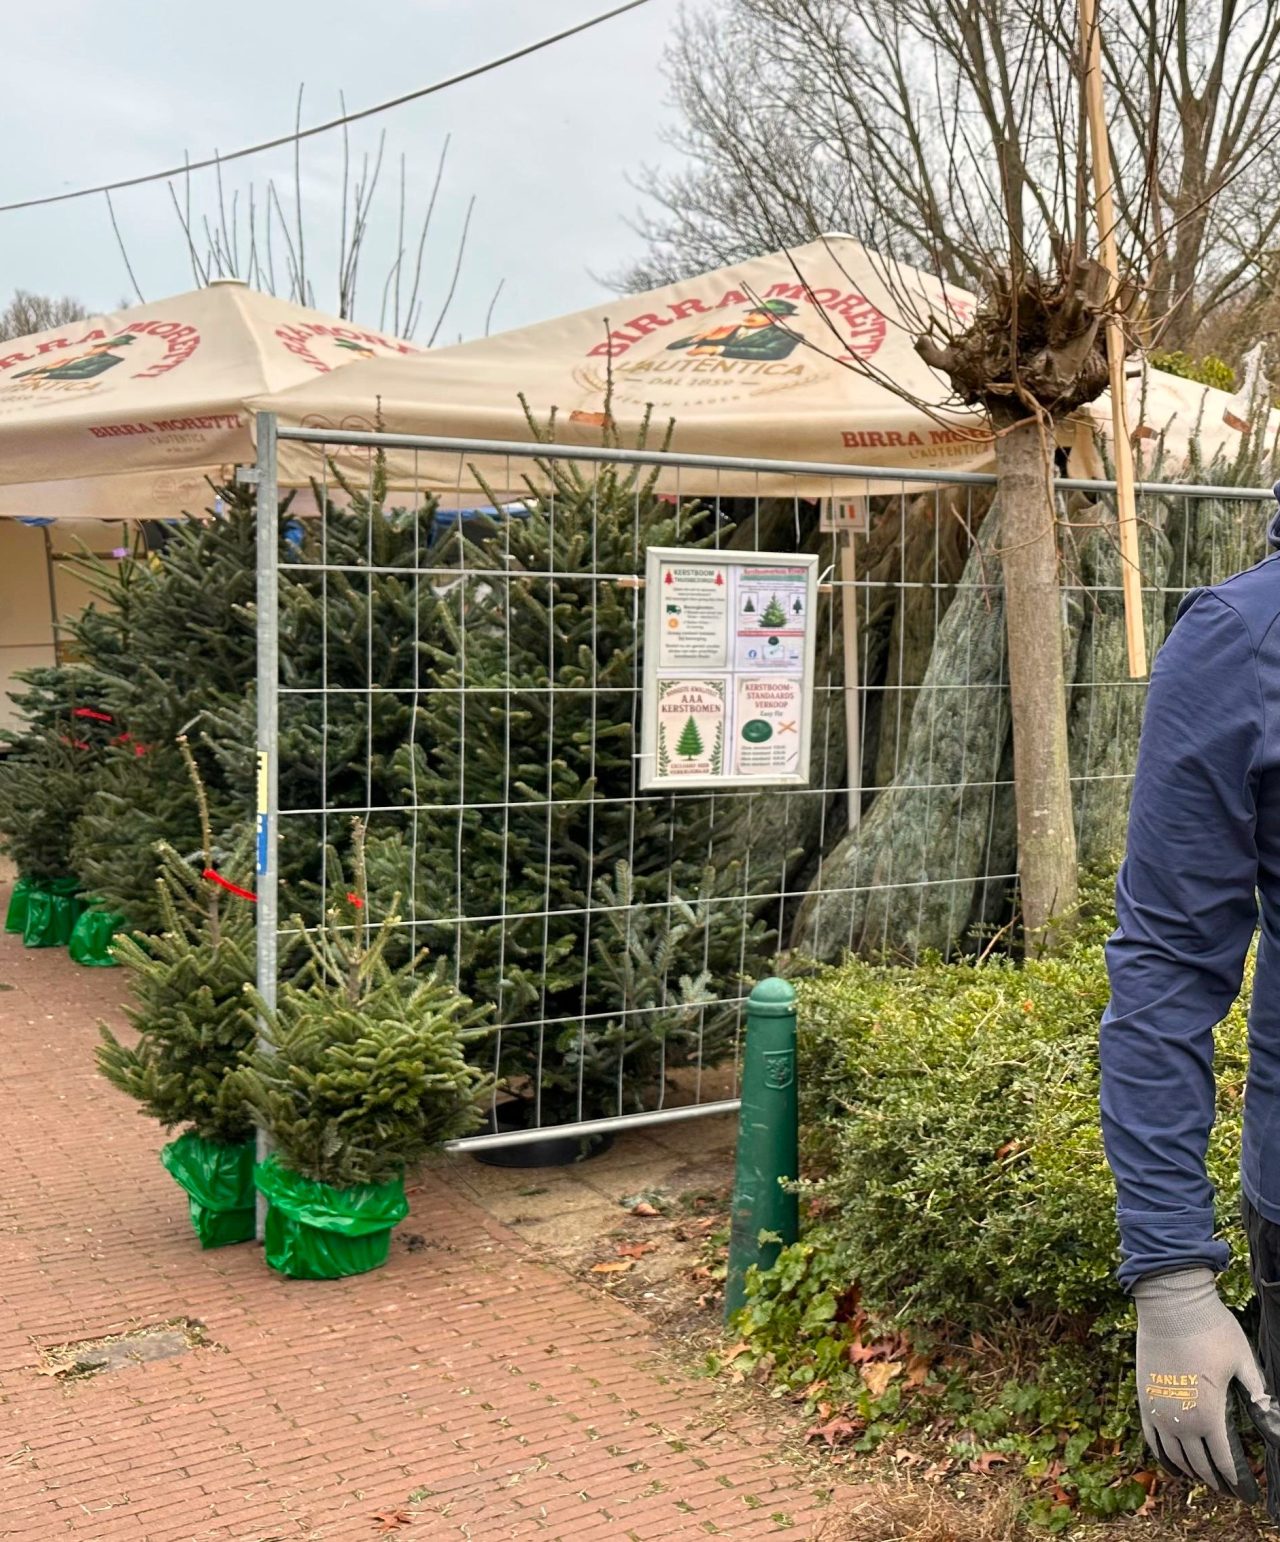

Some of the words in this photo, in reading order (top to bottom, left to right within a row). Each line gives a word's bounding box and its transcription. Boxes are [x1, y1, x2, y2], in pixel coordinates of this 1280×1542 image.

[586, 290, 753, 358] BIRRA
[762, 283, 887, 362] MORETTI
[113, 321, 201, 379] MORETTI
[88, 422, 154, 438] BIRRA
[152, 413, 244, 432] MORETTI
[841, 430, 924, 448] BIRRA
[747, 692, 794, 700] STANDAARDS
[755, 701, 788, 709] VERKOOP
[661, 704, 721, 713] KERSTBOMEN
